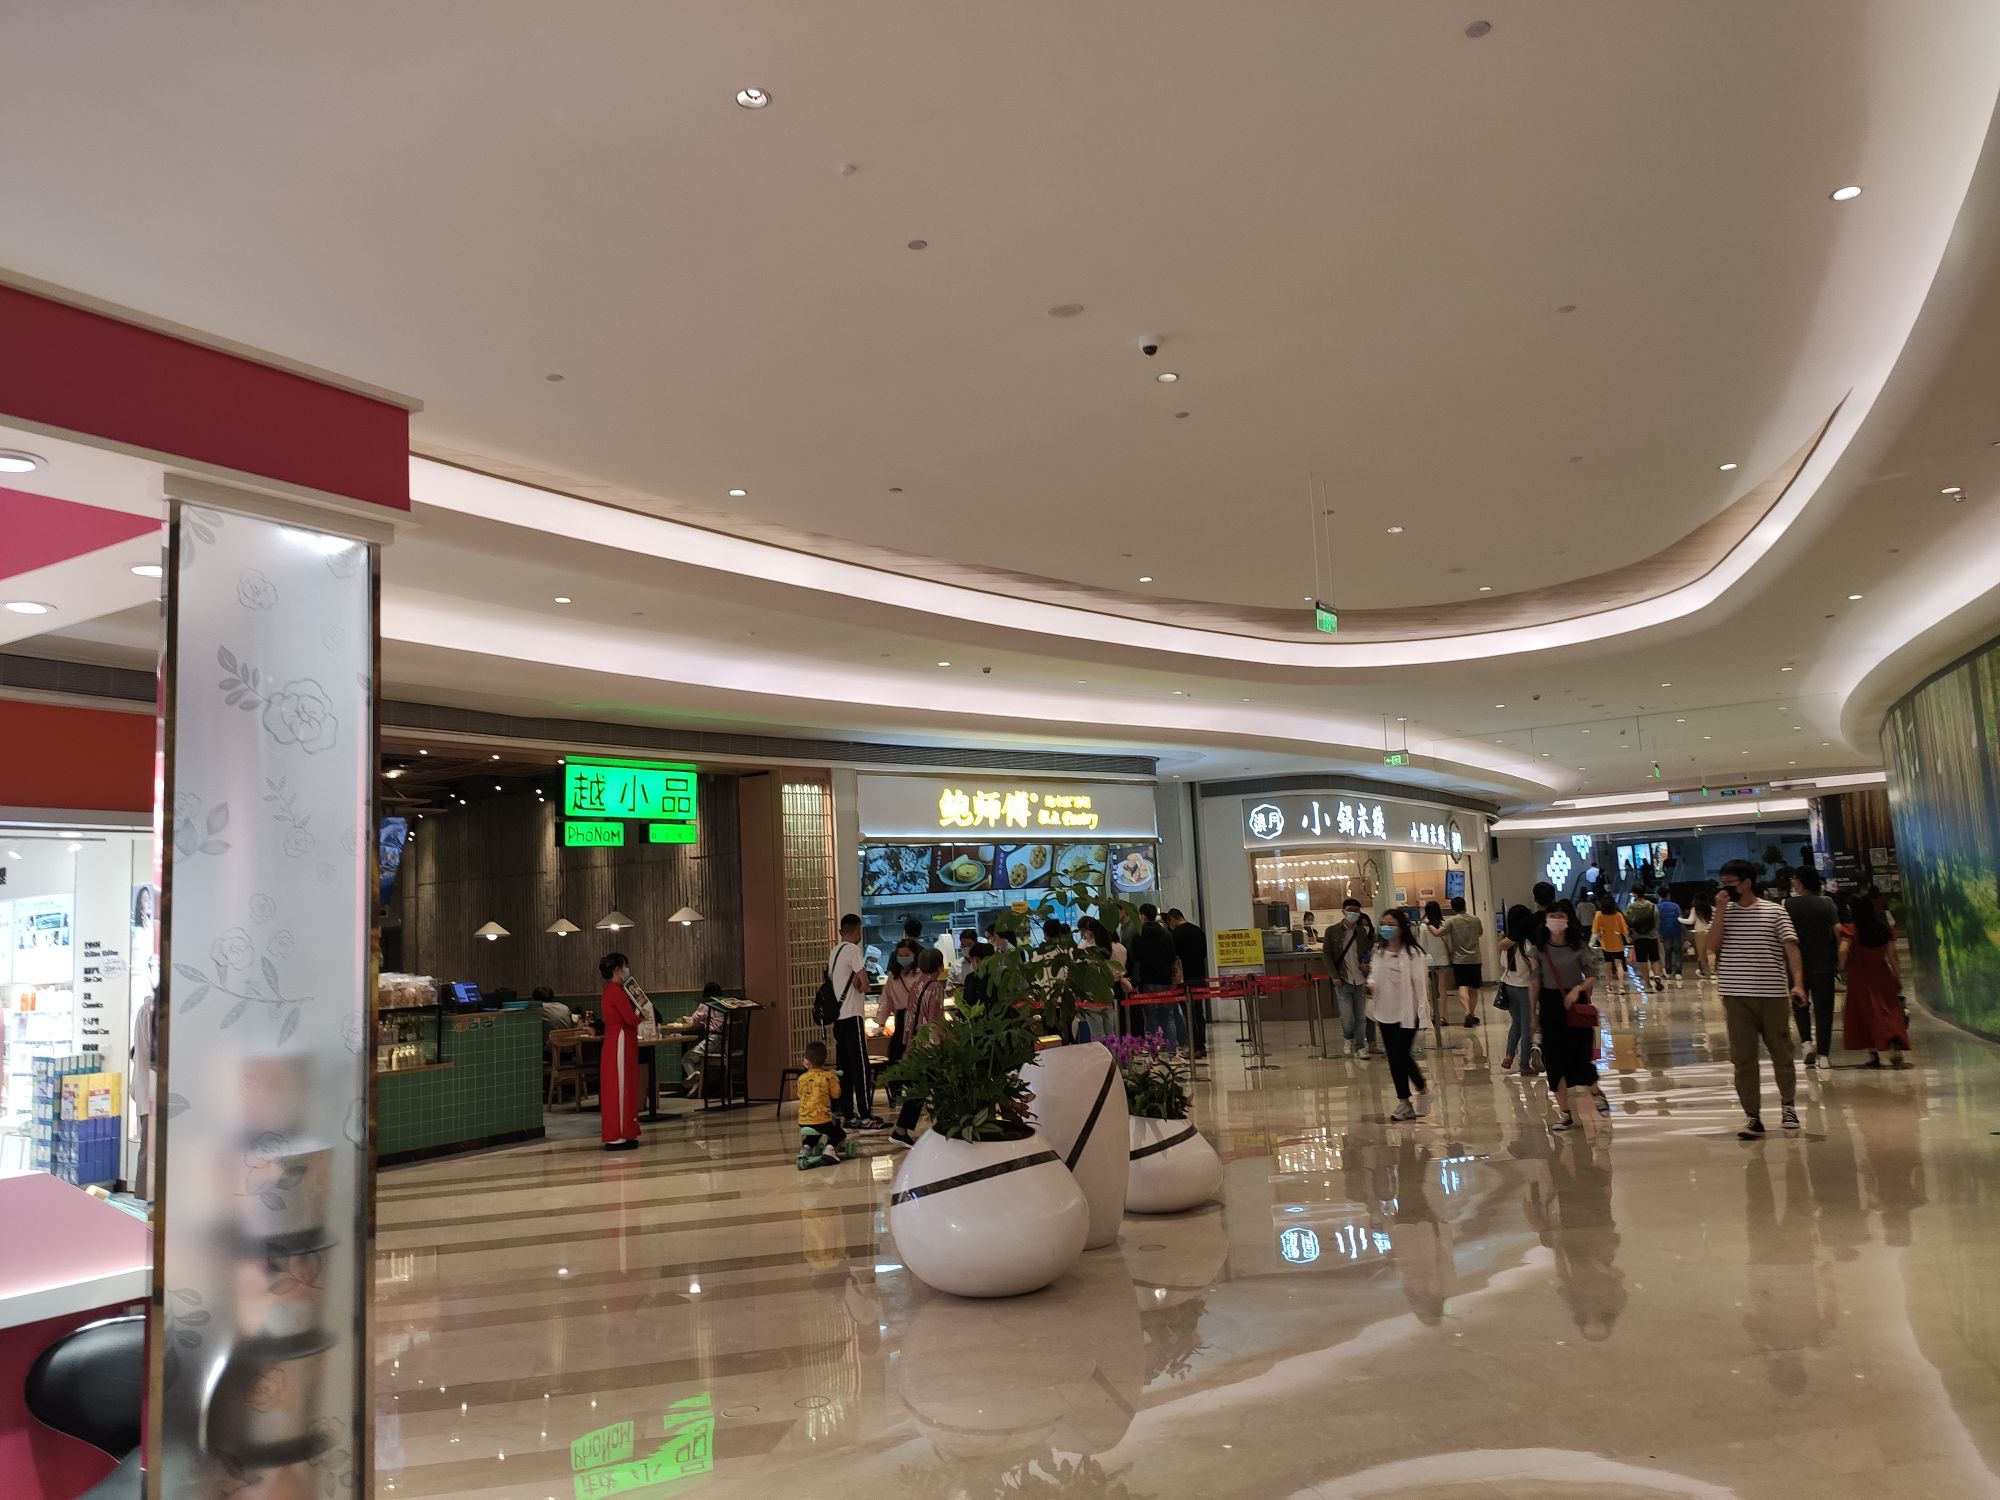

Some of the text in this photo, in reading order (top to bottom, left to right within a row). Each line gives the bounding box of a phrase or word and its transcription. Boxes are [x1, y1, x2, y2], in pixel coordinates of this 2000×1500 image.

[573, 772, 691, 813] 越小品
[939, 788, 1032, 829] 鲍师傅
